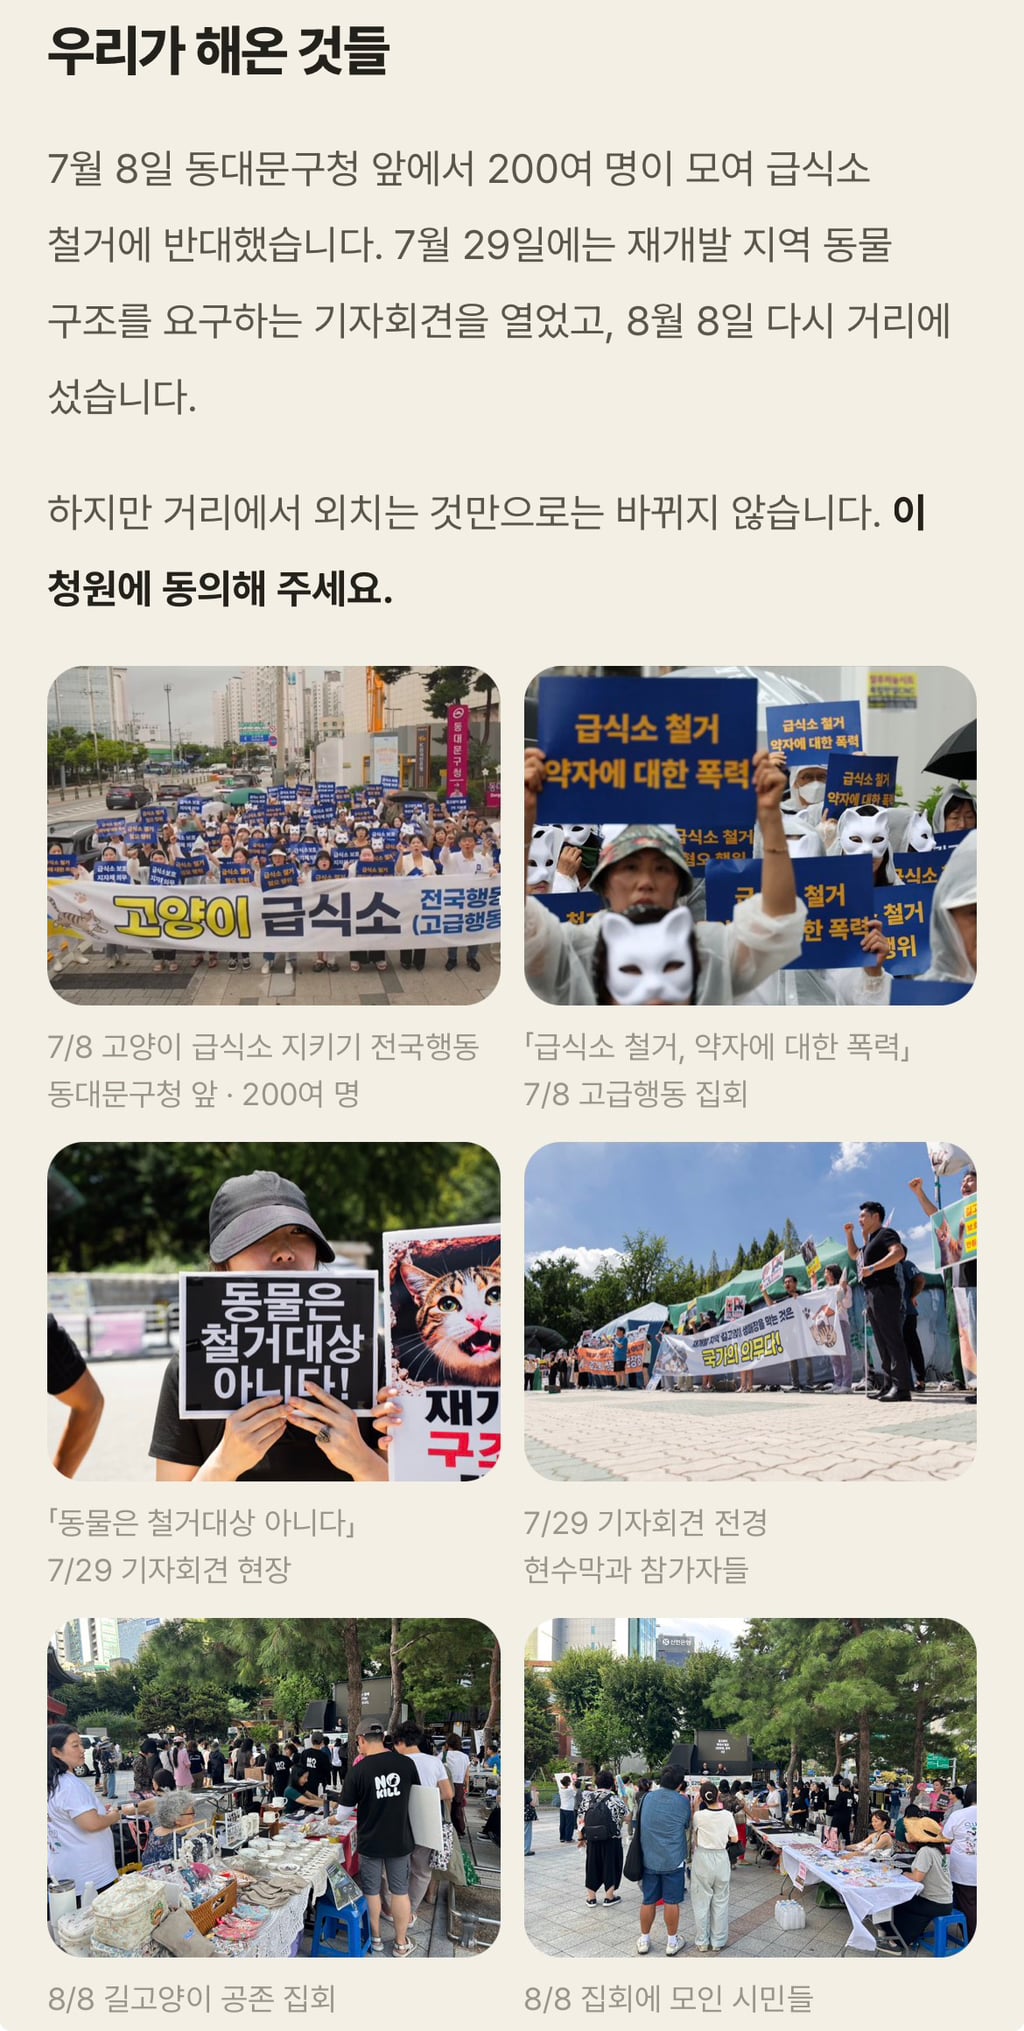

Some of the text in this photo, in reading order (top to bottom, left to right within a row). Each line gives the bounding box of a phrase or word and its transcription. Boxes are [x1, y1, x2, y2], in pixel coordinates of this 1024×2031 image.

[575, 713, 719, 744] 급식소 철거
[782, 715, 845, 733] 급식소 철거
[454, 722, 462, 777] 동대문구청
[770, 734, 860, 752] 약자에 대한 폭력
[545, 758, 749, 789] 약자에 대한 폭력
[843, 771, 890, 787] 급식소 철거
[827, 791, 860, 806] 약자에
[723, 828, 754, 845] 철거
[804, 883, 846, 908] 철거
[113, 895, 251, 939] 고양이
[261, 891, 402, 937] 급식소
[883, 901, 924, 926] 철거
[828, 916, 870, 941] 폭력
[221, 1282, 345, 1323] 동물은
[201, 1323, 365, 1364] 철거대상
[703, 1331, 783, 1367] 국가의 의무다!
[214, 1365, 349, 1405] 아니다!
[375, 1773, 400, 1789] NO
[377, 1787, 400, 1799] KILL
